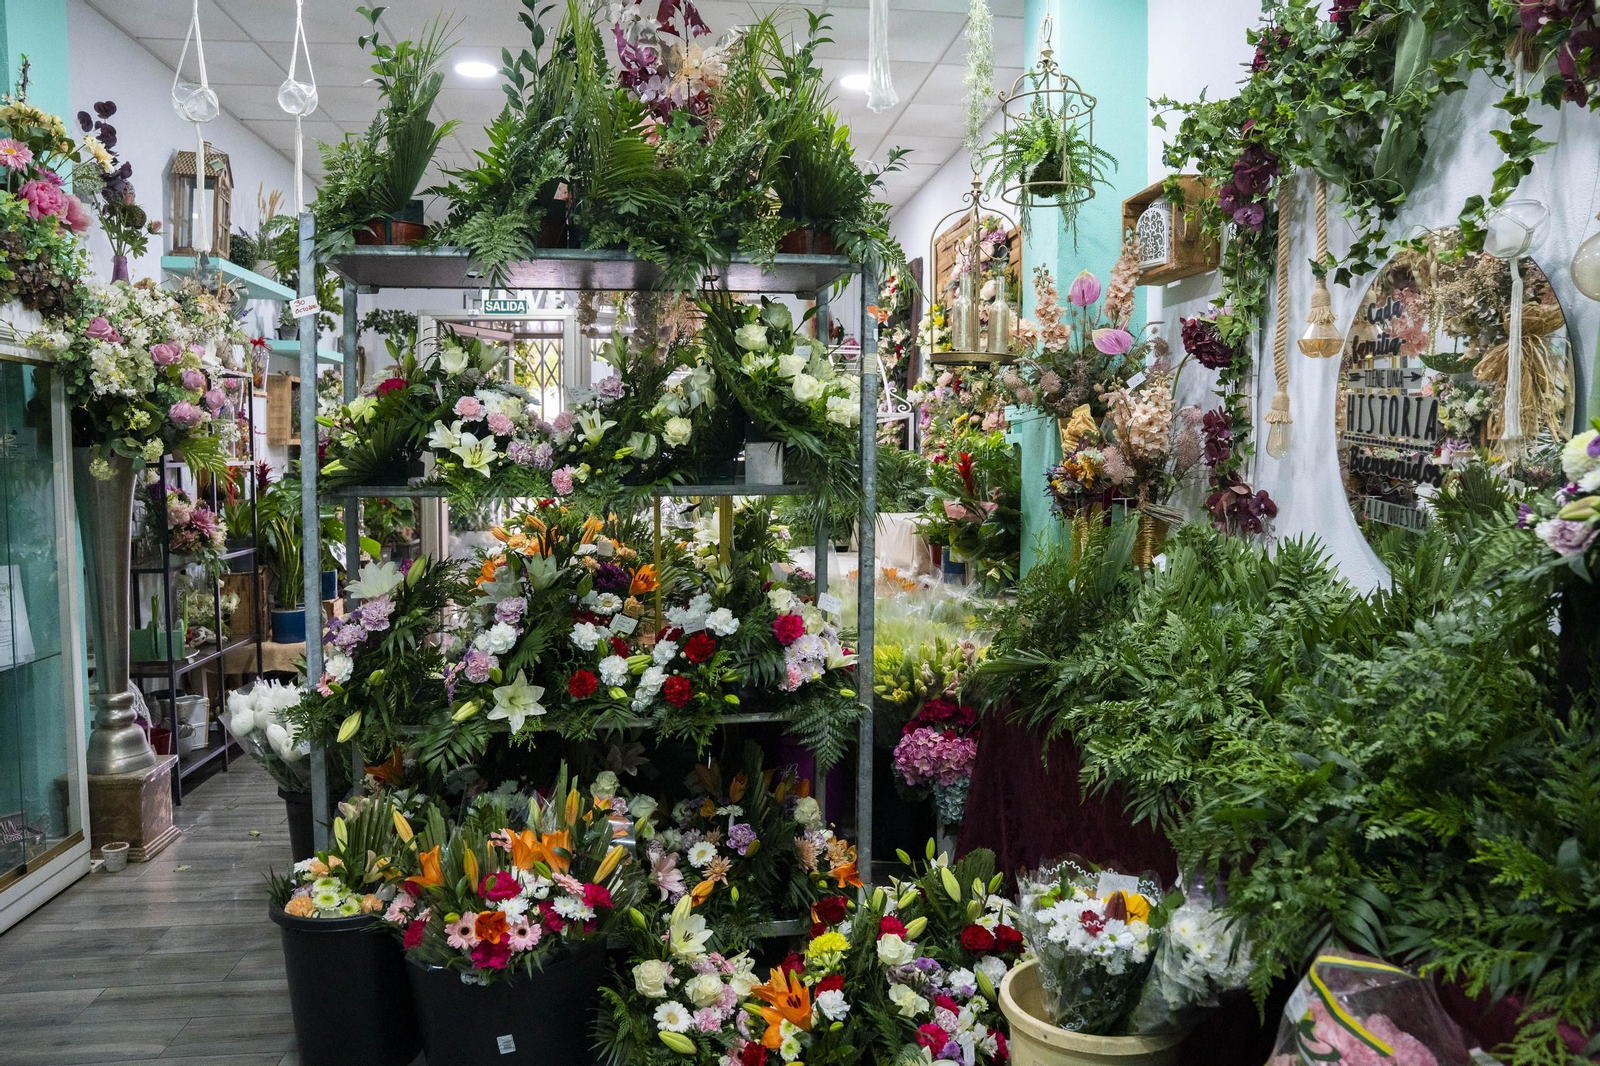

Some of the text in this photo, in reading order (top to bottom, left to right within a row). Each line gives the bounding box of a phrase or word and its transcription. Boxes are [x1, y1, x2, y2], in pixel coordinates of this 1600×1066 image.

[485, 301, 526, 312] SALIDA
[1364, 296, 1403, 325] Cada
[1351, 331, 1407, 364] familia
[1364, 369, 1405, 389] TIENE UNA
[1346, 393, 1438, 441] HISTORIA
[1349, 445, 1446, 489] Bienvenidos
[1366, 499, 1428, 532] A LA NUESTRA
